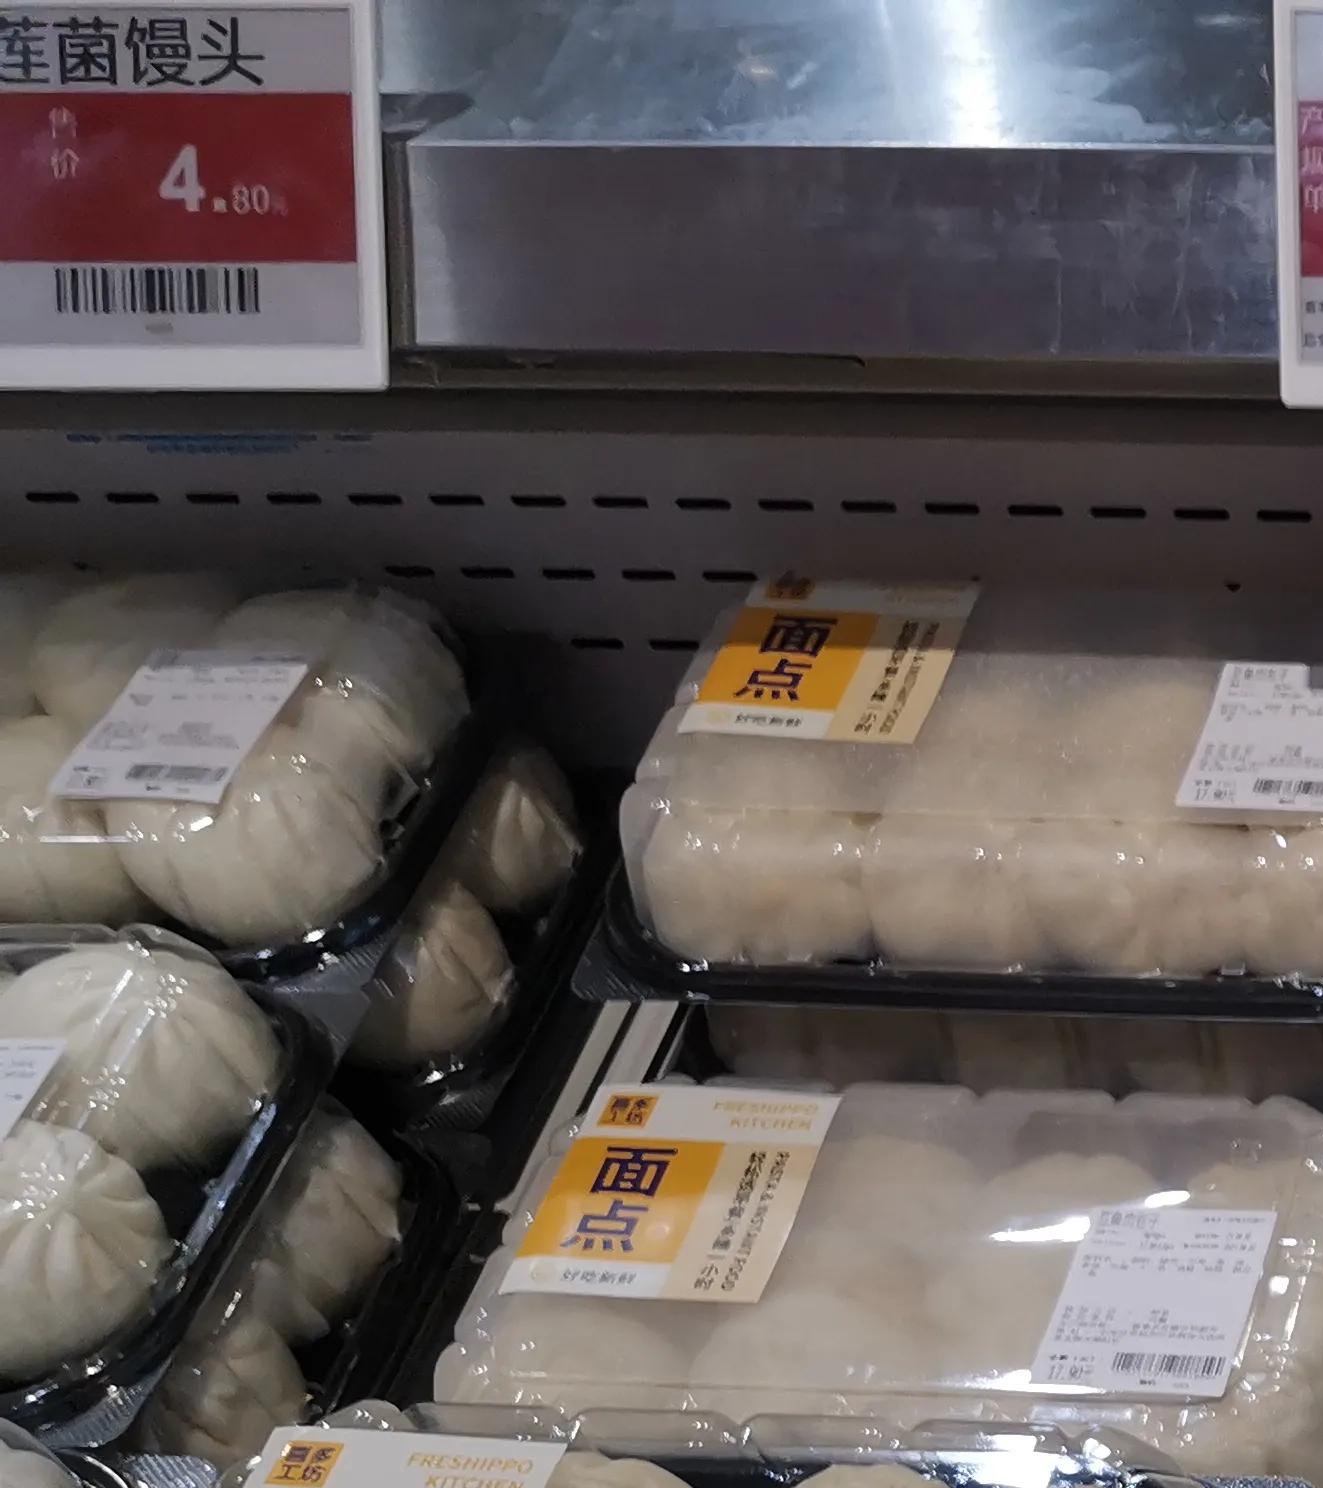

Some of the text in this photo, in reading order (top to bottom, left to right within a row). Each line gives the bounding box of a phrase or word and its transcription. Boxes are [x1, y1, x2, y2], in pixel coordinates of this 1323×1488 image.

[733, 614, 838, 702] 面点
[560, 1147, 679, 1253] 面点
[407, 1453, 534, 1473] FRESHIPPO
